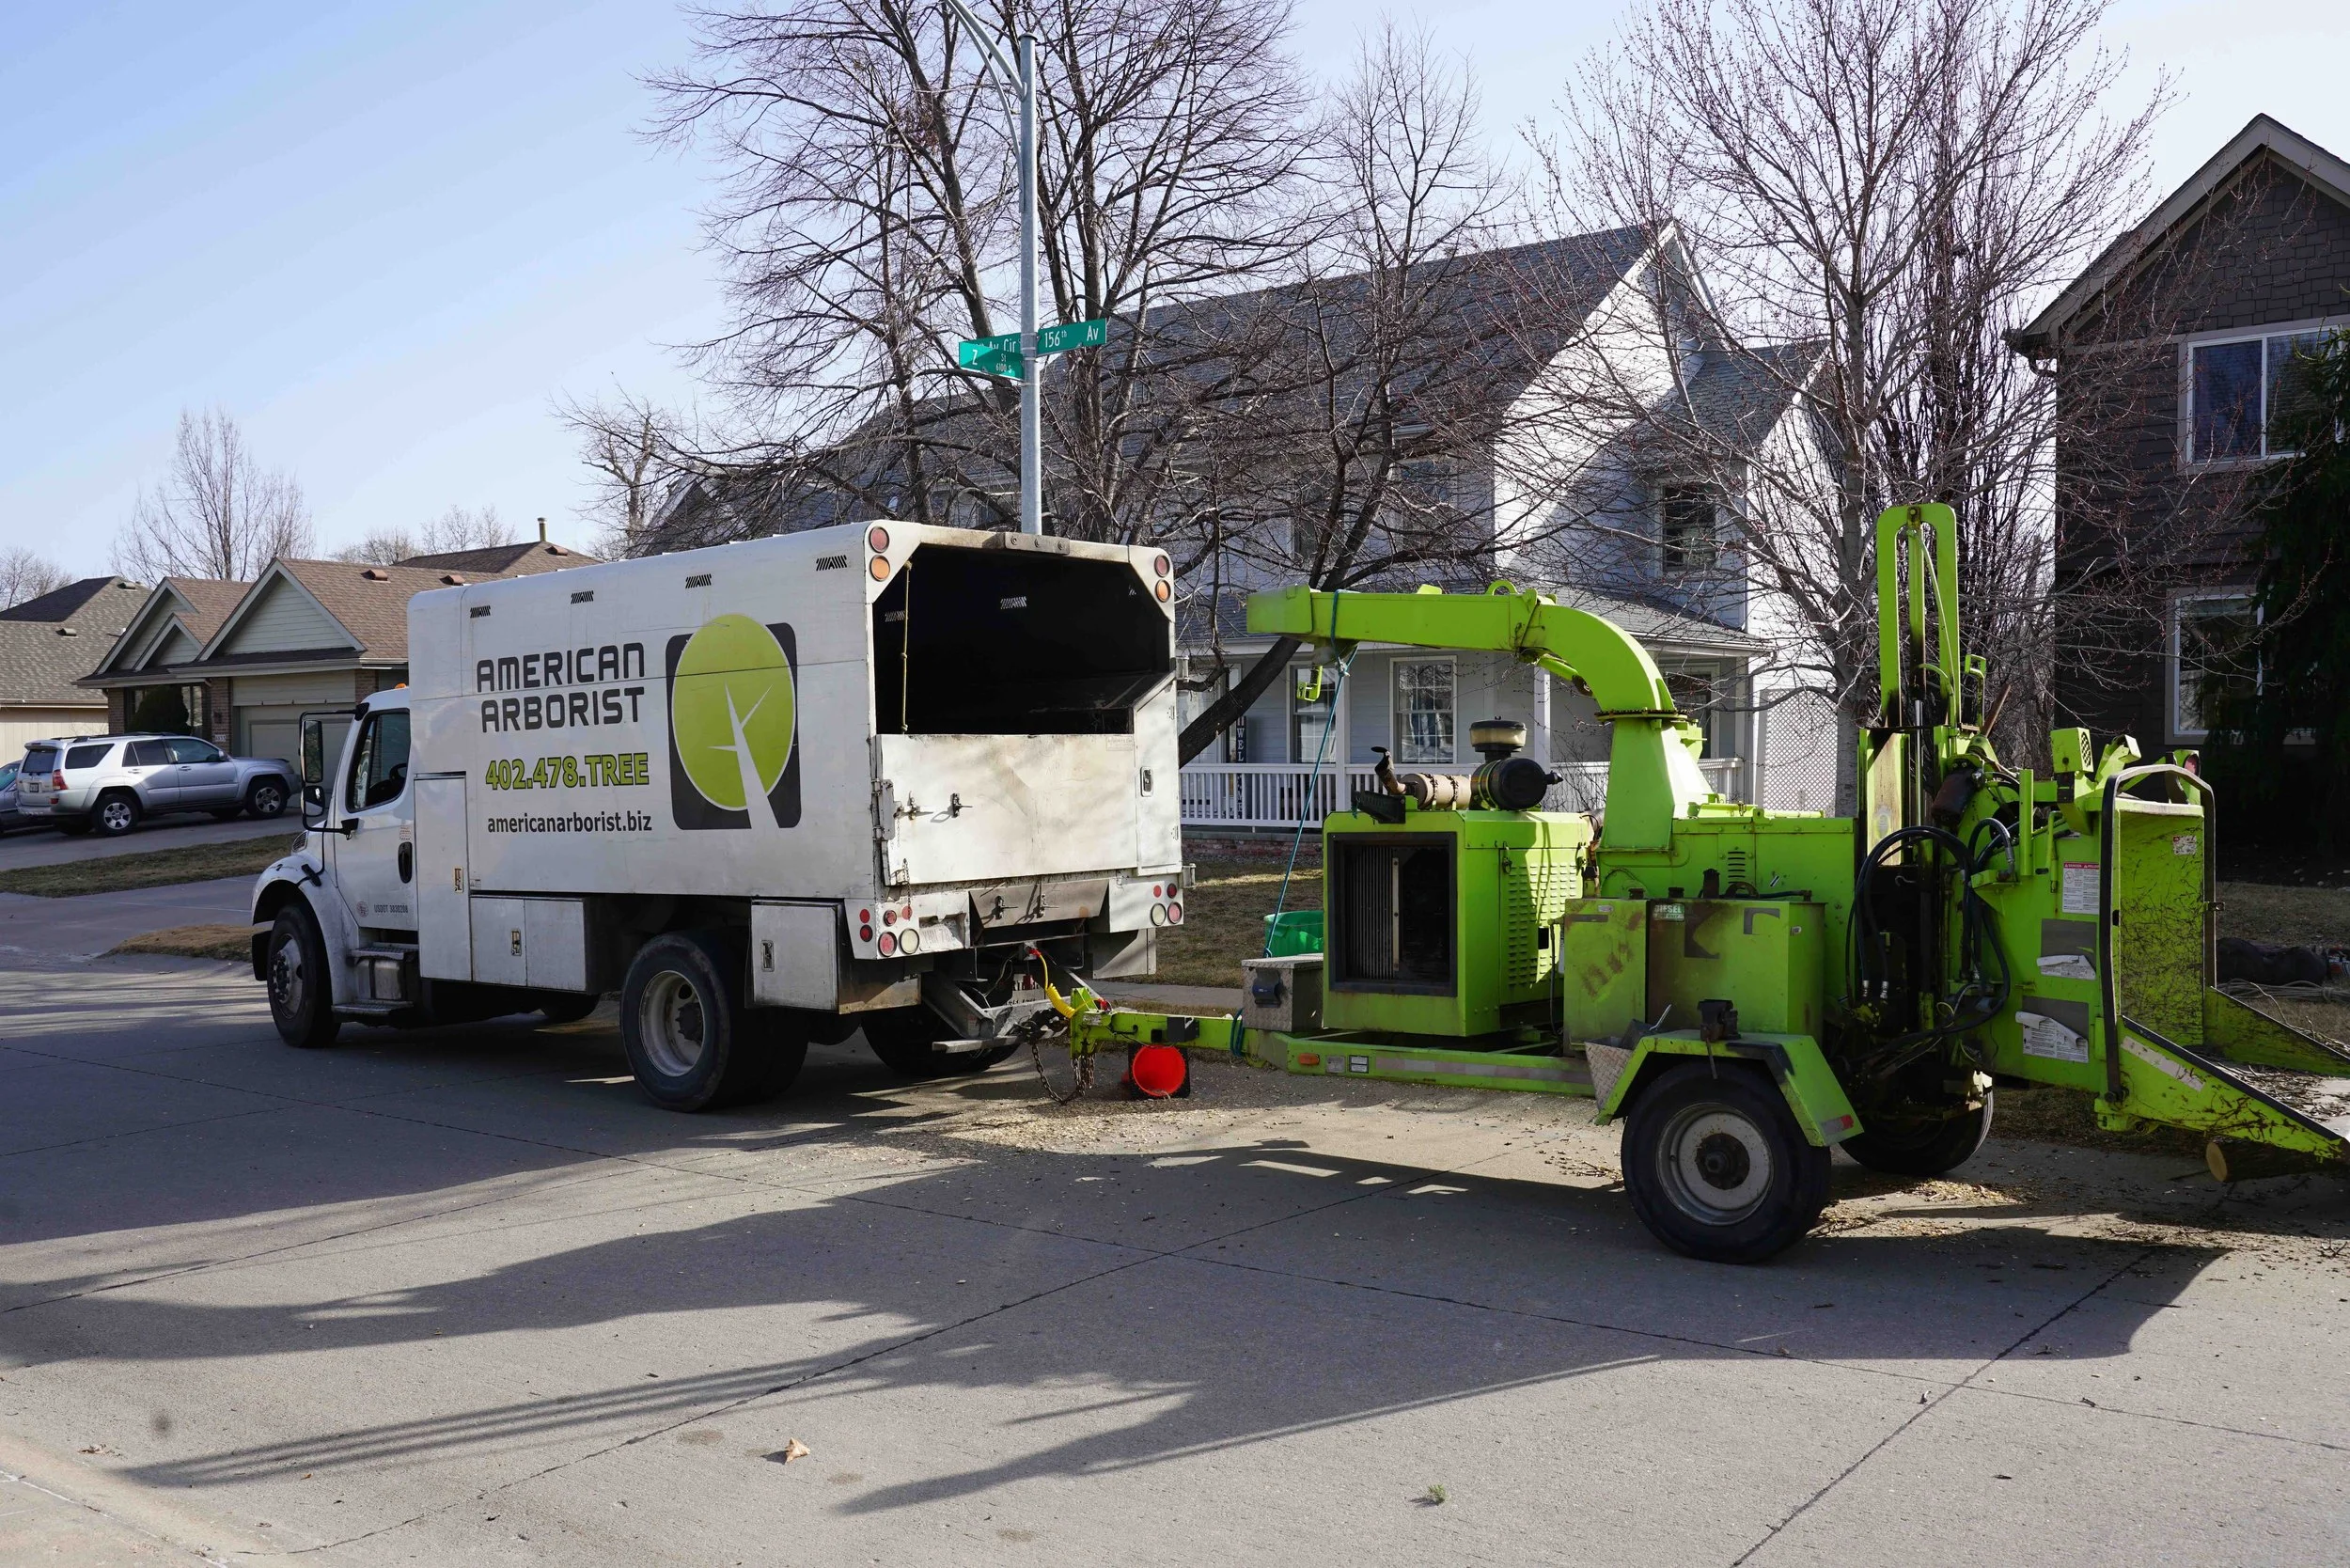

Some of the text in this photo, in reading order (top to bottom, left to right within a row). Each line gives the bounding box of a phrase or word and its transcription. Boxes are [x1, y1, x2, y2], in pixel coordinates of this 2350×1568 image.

[1003, 338, 1016, 353] Cir
[1044, 325, 1099, 348] 156th Av
[972, 349, 1006, 366] Z St
[477, 642, 645, 693] AMERICAN
[481, 686, 645, 733] ARBORIST
[485, 752, 650, 791] 402.478.TREE
[488, 810, 652, 833] americanarborist.biz
[1654, 904, 1682, 913] DIESEL
